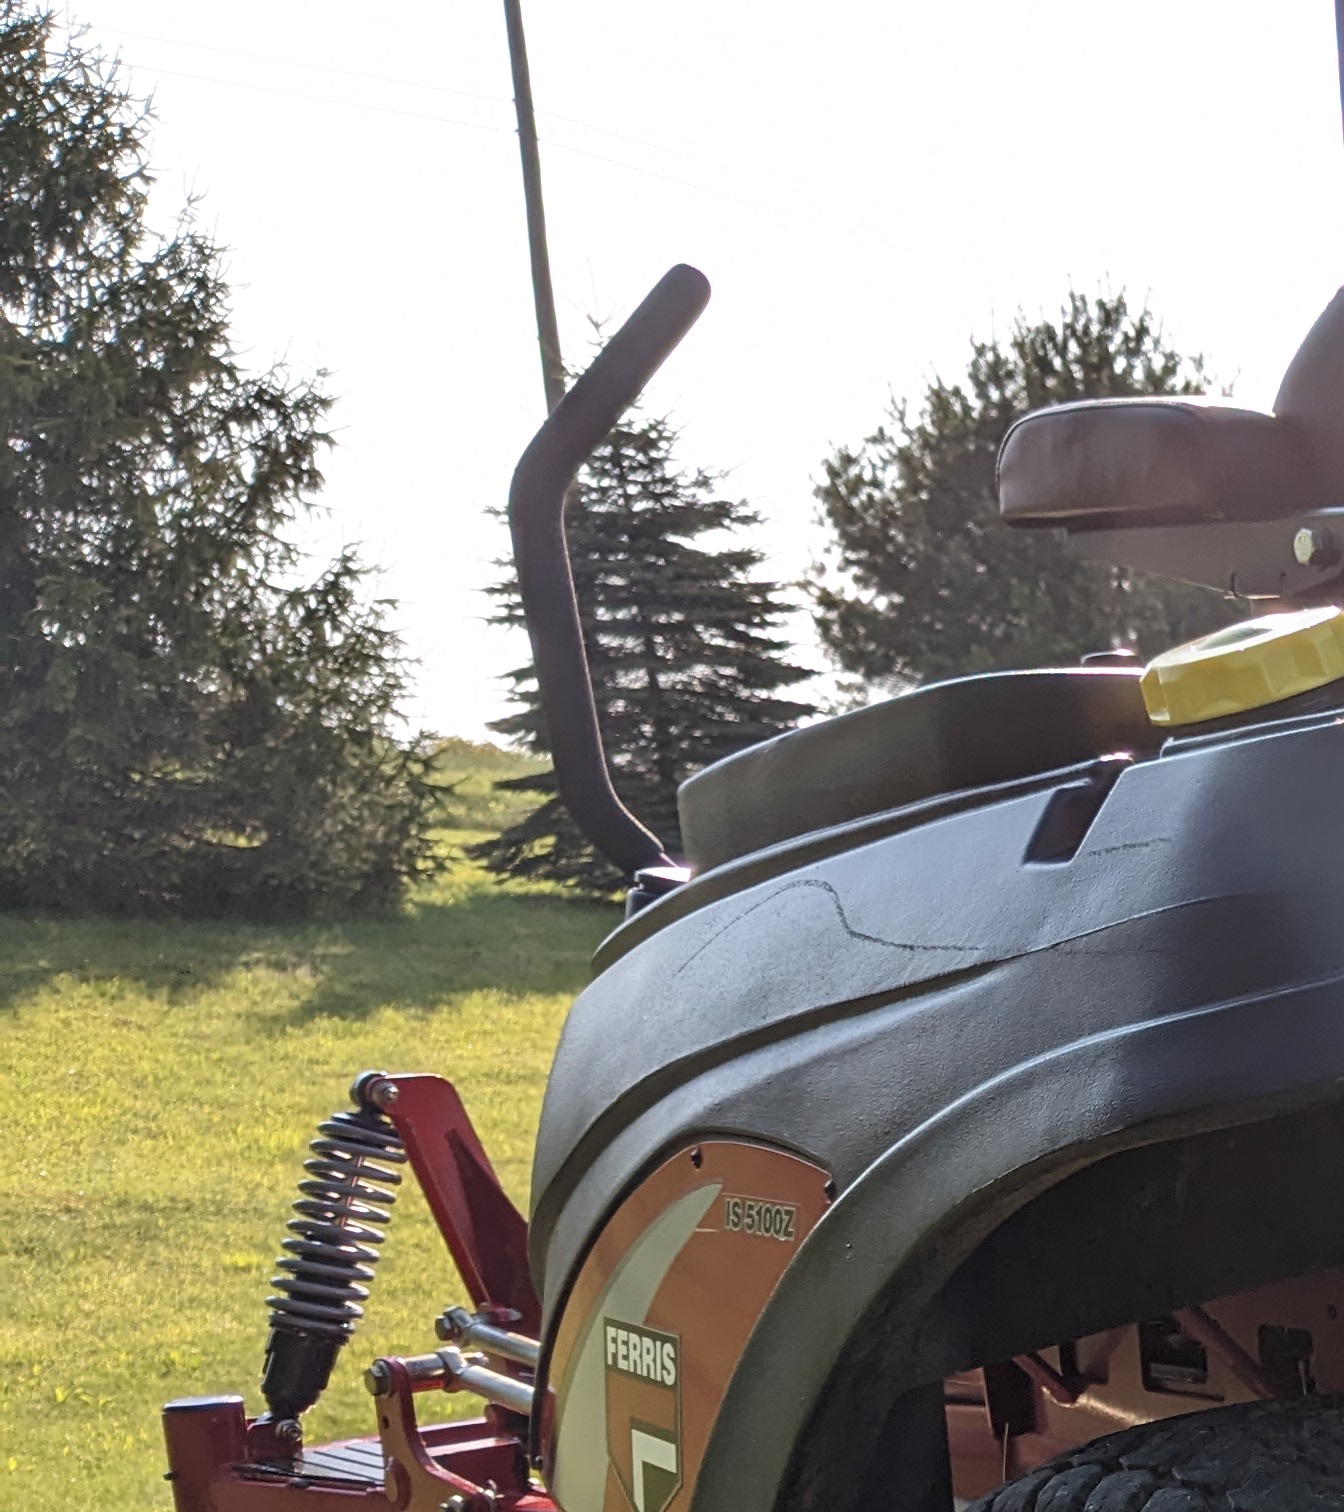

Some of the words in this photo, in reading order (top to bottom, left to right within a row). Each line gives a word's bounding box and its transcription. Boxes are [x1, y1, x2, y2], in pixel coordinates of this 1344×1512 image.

[724, 1198, 742, 1231] IS
[744, 1200, 796, 1241] 5100Z
[606, 1326, 676, 1386] FERRIS
